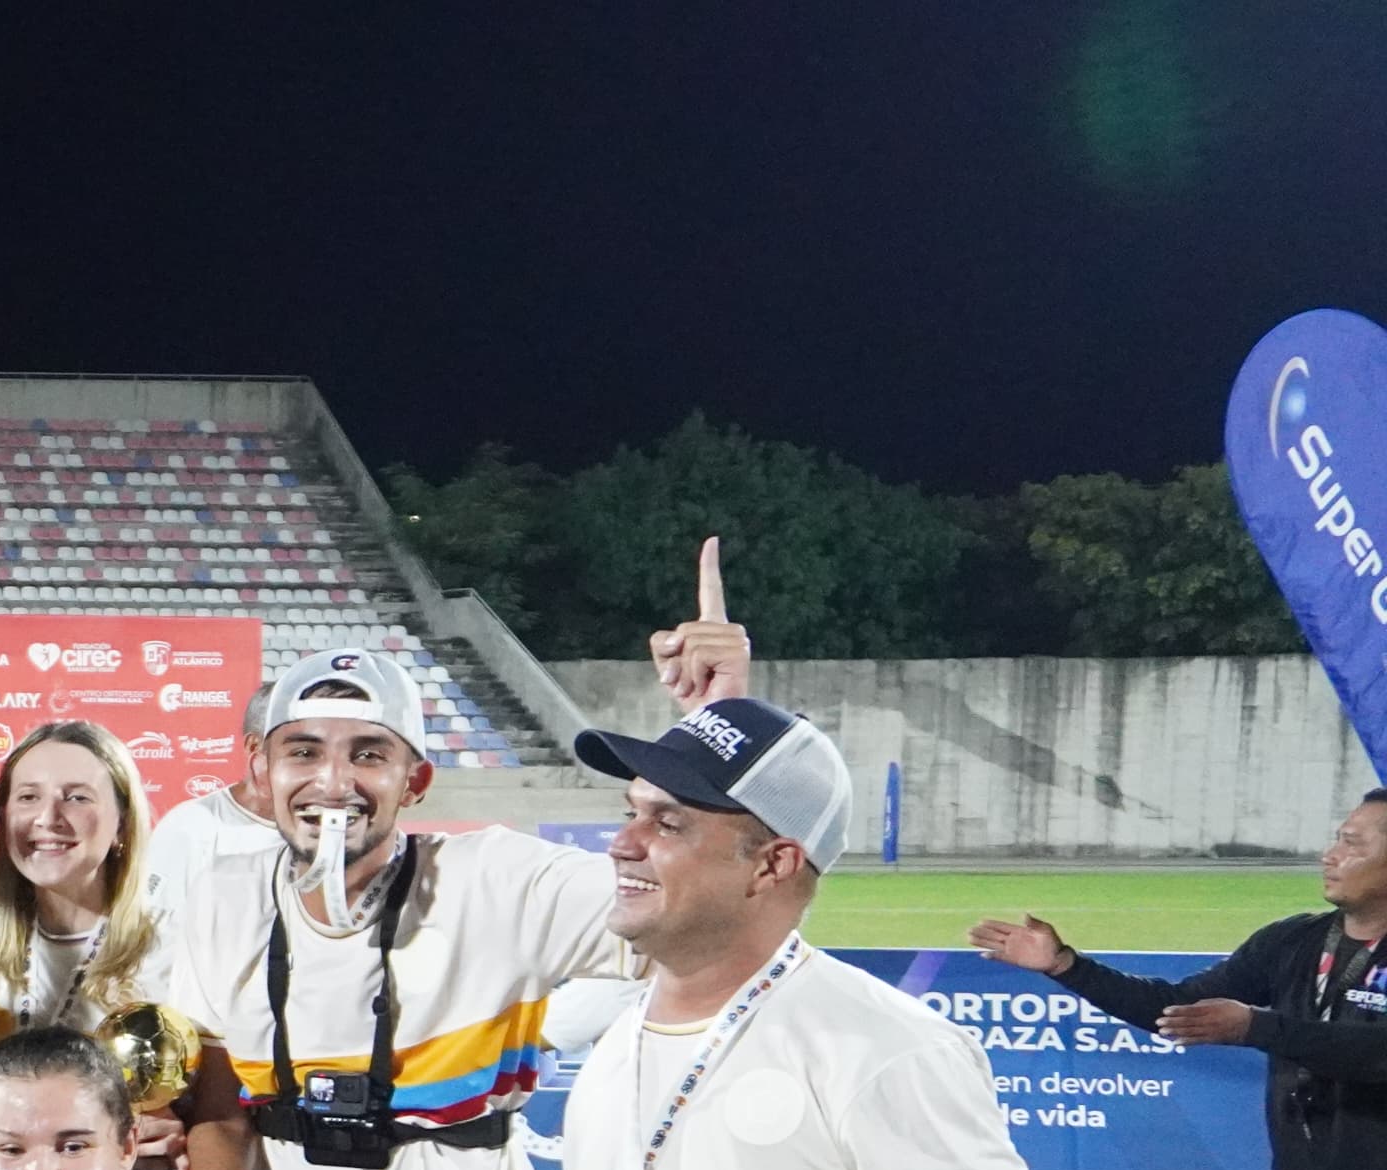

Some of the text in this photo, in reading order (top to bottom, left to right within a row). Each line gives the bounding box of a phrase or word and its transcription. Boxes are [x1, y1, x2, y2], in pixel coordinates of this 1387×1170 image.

[62, 649, 122, 668] cirec
[183, 691, 231, 703] RANGEL
[132, 747, 174, 758] ctrolit
[1075, 1027, 1186, 1054] S.A.S.
[1040, 1072, 1174, 1097] devolver
[1037, 1104, 1107, 1128] vida
